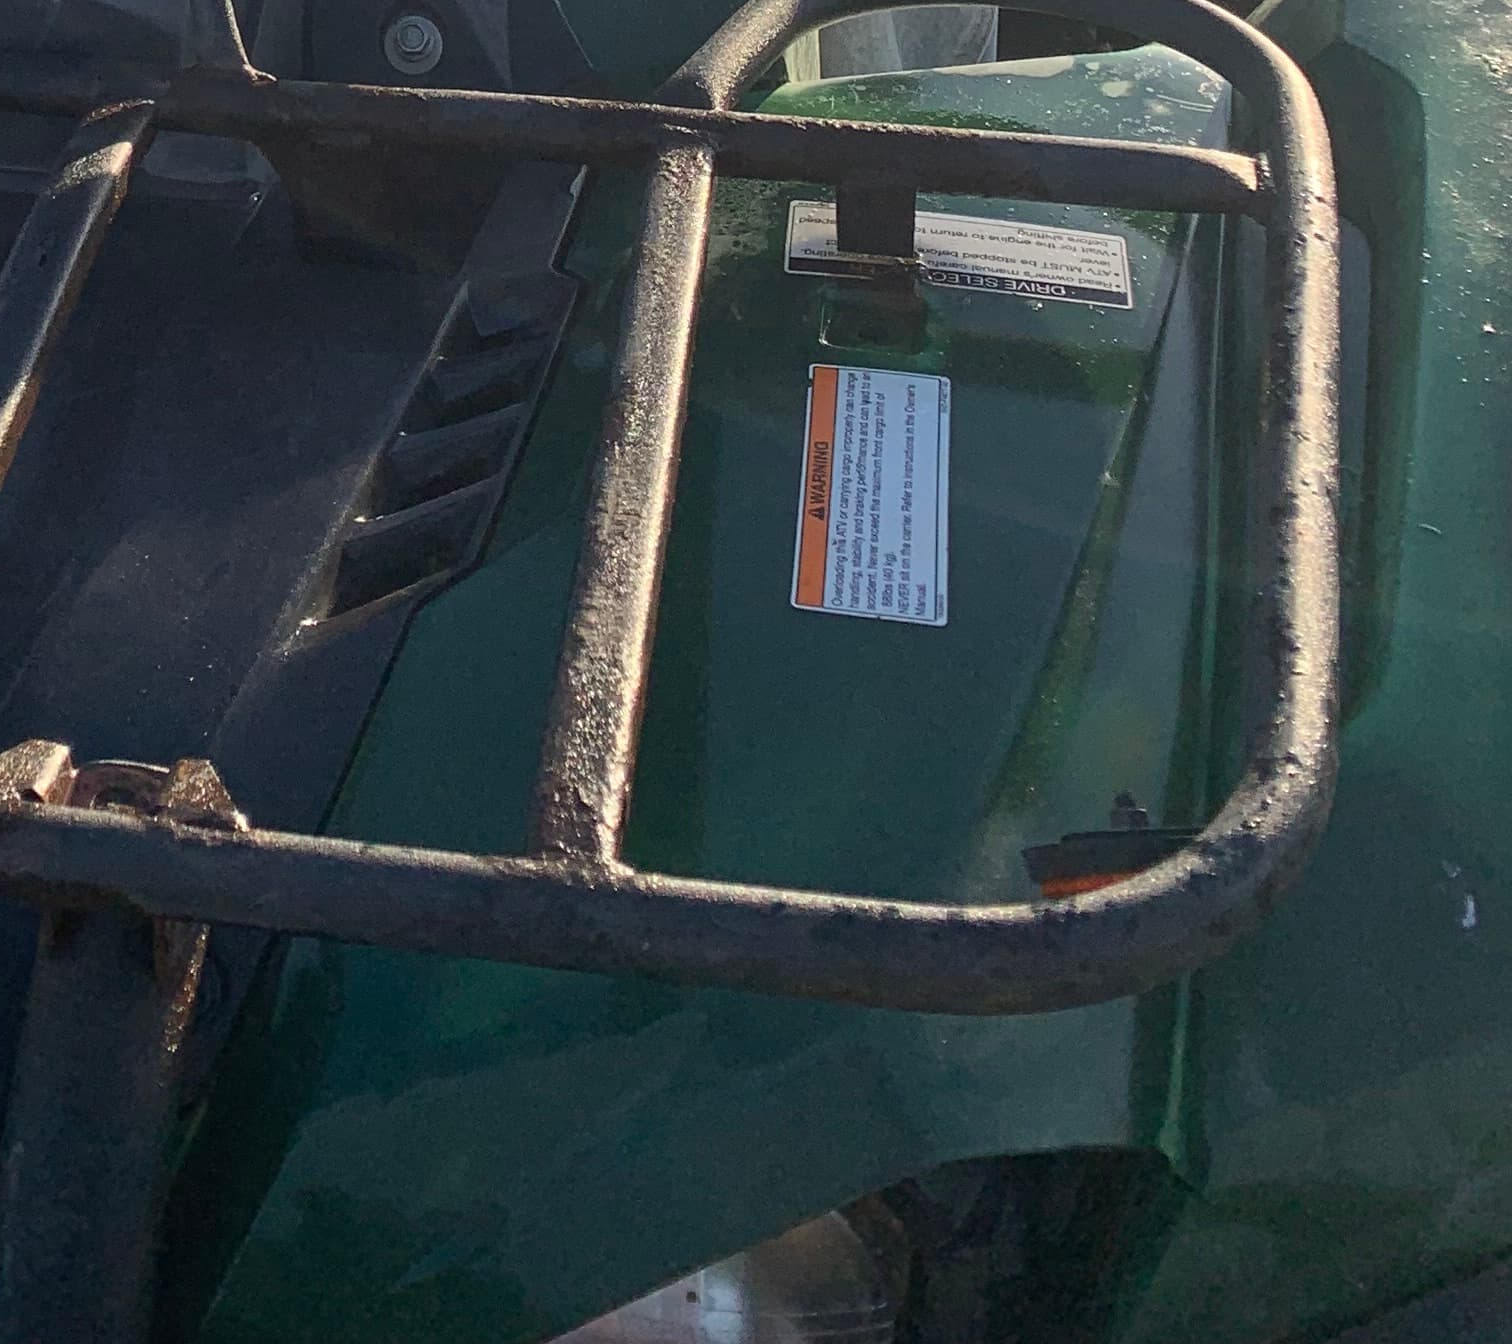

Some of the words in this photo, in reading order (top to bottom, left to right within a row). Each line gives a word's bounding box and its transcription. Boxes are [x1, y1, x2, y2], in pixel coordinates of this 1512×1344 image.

[1034, 240, 1056, 249] the
[1060, 243, 1077, 253] for
[1079, 245, 1110, 256] Wait
[1019, 258, 1037, 267] be
[1040, 260, 1082, 273] MUST
[929, 268, 998, 289] SELEC
[1002, 278, 1066, 297] DRIVE
[809, 439, 829, 506] WARNING
[841, 453, 854, 476] cargo
[838, 476, 853, 509] carrying
[900, 489, 912, 512] Refer
[835, 519, 848, 537] ATV
[830, 554, 848, 607] Overloading
[897, 582, 910, 615] NEVER
